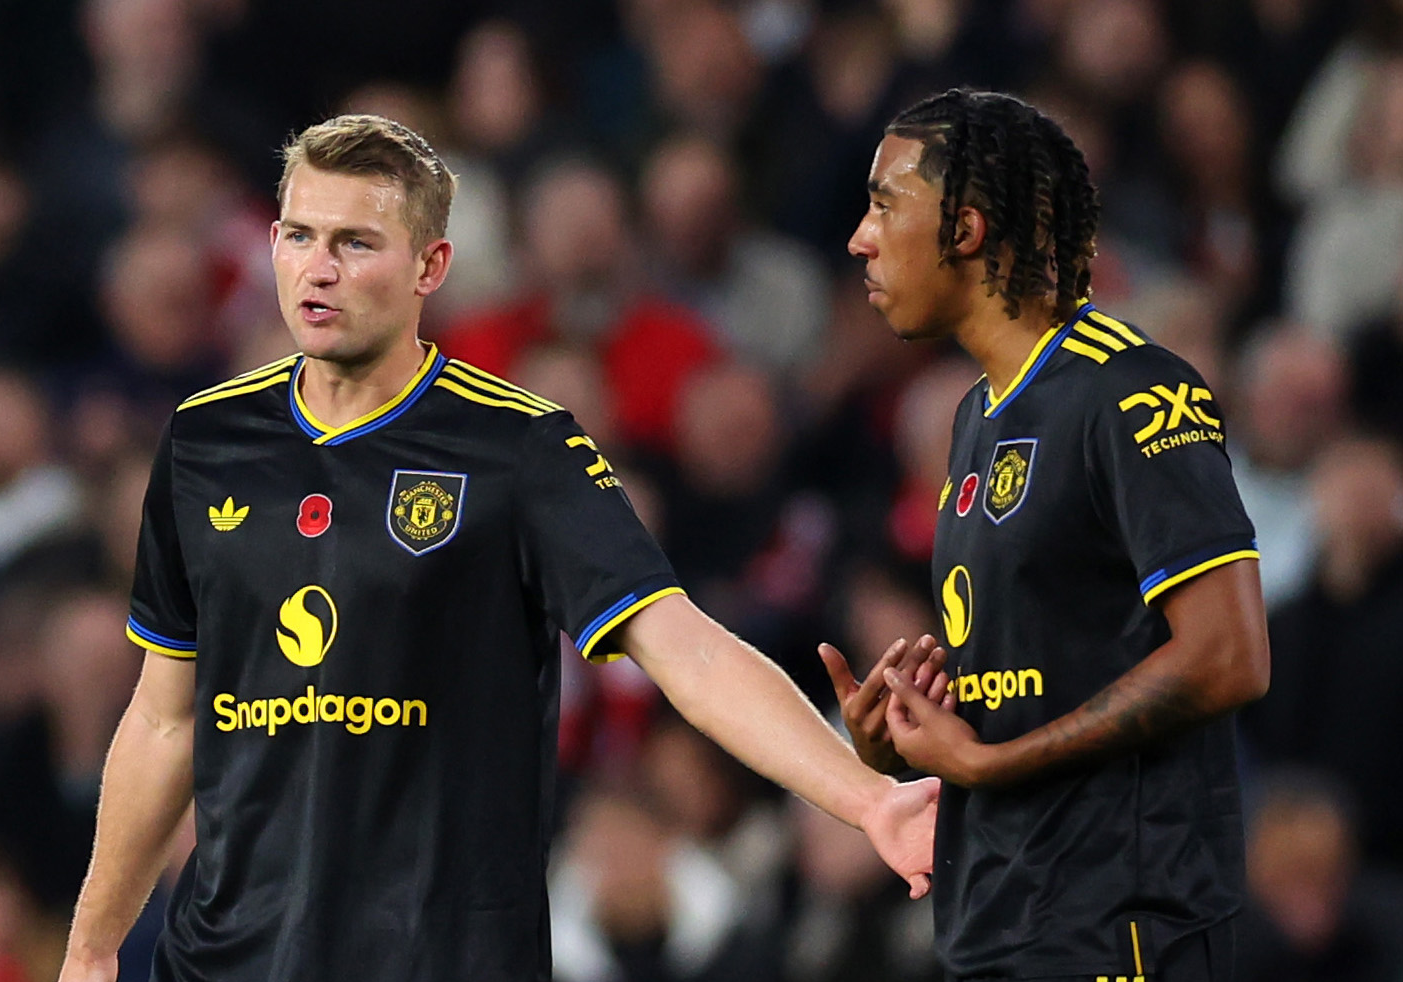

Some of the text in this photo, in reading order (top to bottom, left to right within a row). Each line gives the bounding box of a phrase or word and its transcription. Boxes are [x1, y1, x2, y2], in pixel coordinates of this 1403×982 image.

[1118, 382, 1221, 444] DXC
[402, 485, 449, 507] MANCHESTER
[404, 524, 438, 537] UNITED
[213, 685, 427, 736] Snapdragon
